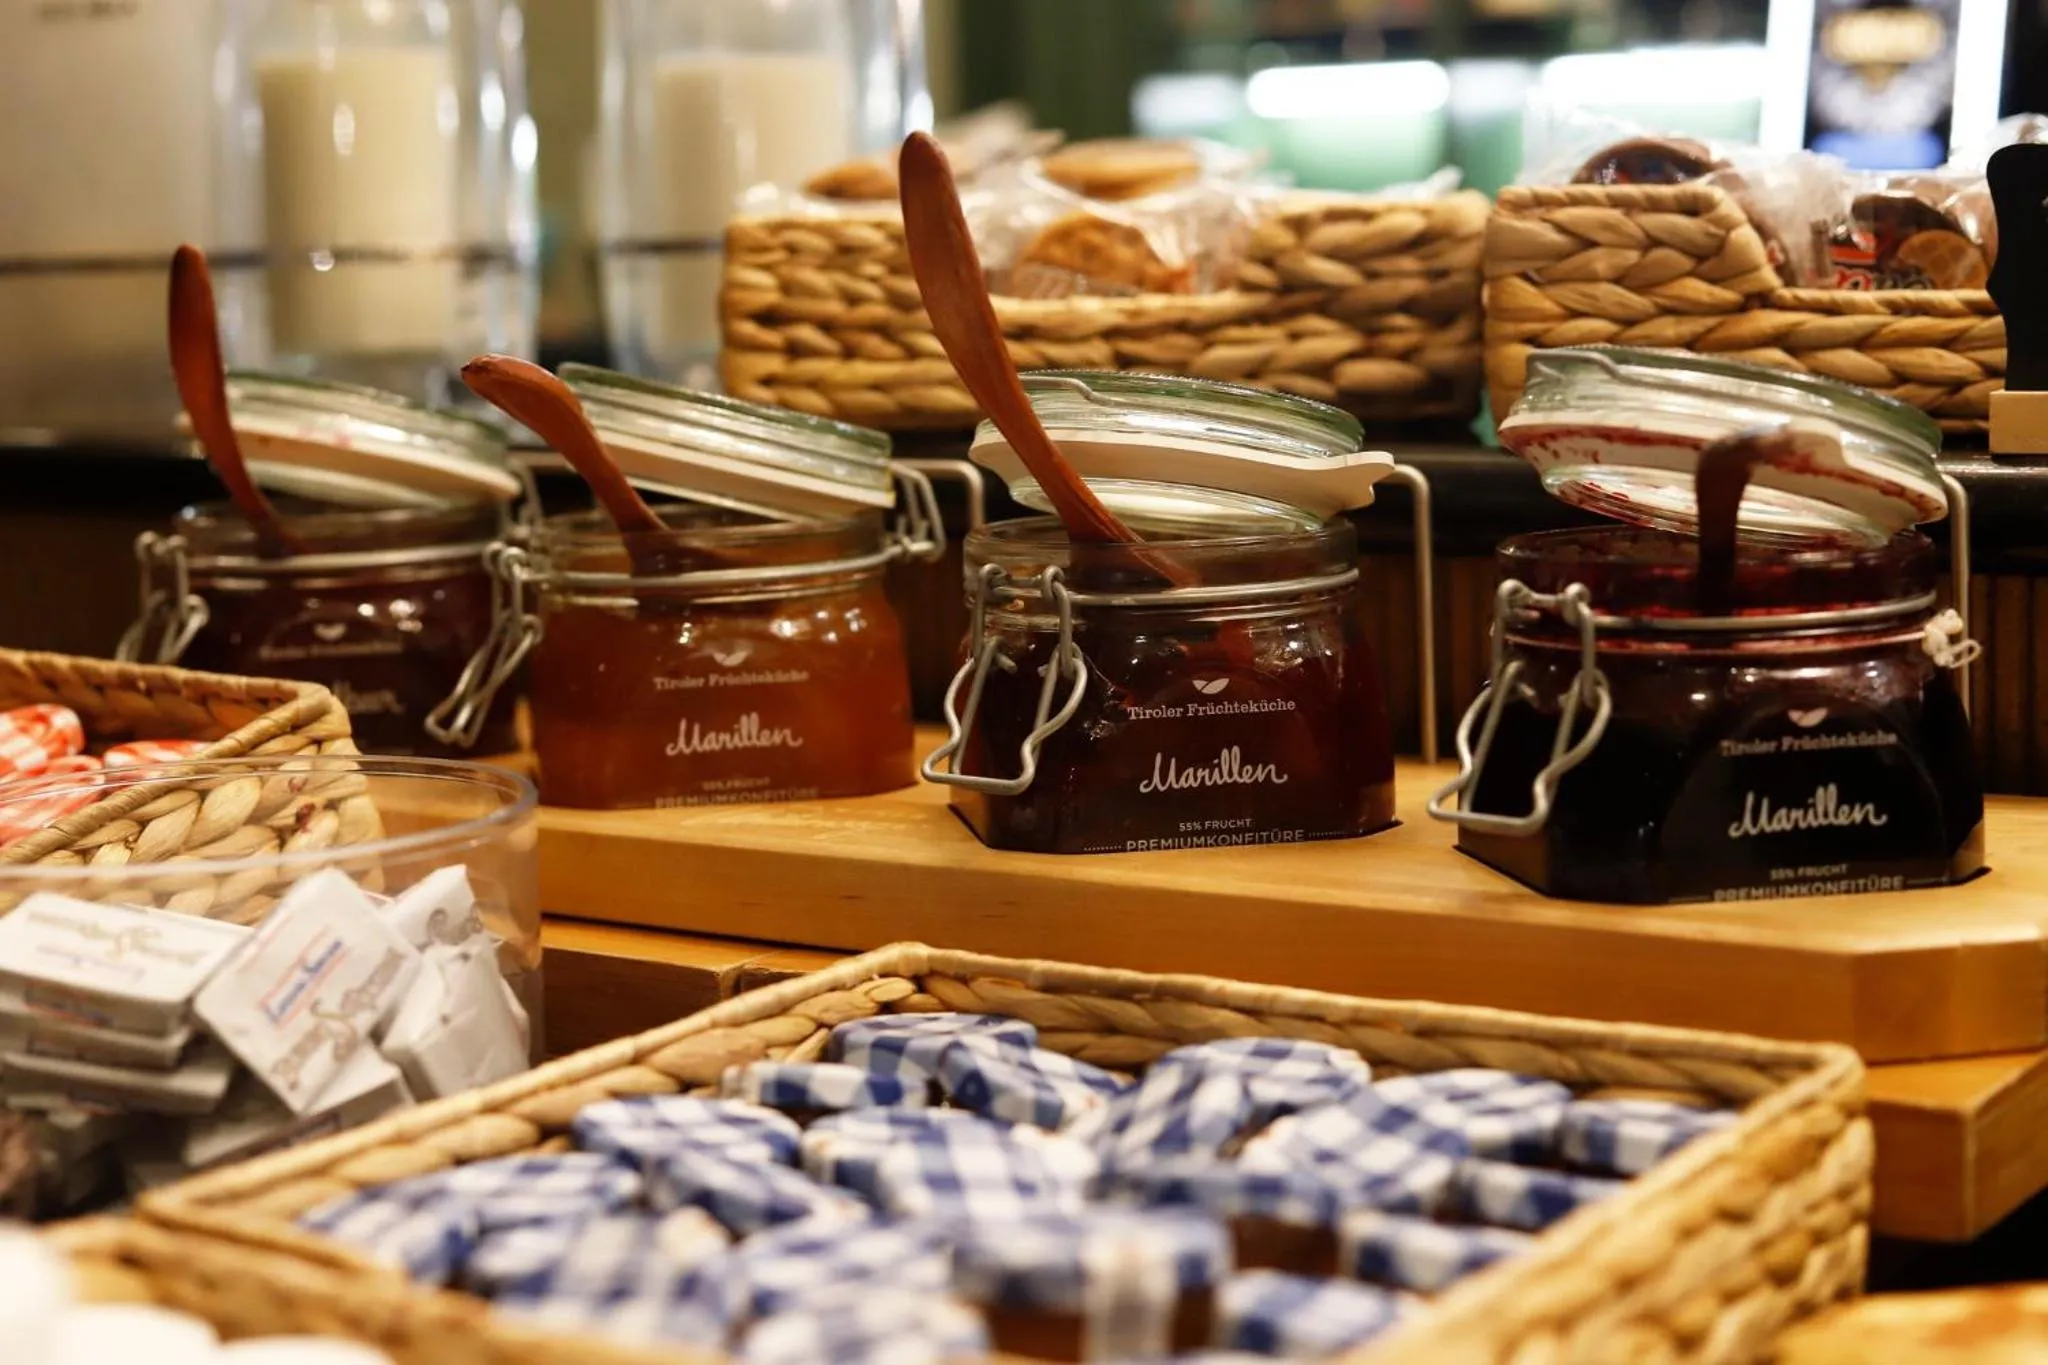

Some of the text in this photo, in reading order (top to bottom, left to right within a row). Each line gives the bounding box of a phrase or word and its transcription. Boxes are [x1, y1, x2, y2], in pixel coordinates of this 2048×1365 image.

[1127, 698, 1296, 720] Tiroler Früchteküche
[665, 711, 803, 756] Marillen
[1720, 730, 1898, 756] Tiroler Früchteküche
[1139, 745, 1288, 794] Marillen
[1728, 783, 1888, 838] Marillen
[1179, 818, 1252, 832] 55% FRUCHT
[1126, 829, 1305, 851] PREMIUMKONFITÜRE
[1797, 863, 1848, 878] FRUCHT
[1713, 874, 1904, 902] PREMIUMKONFITÜRE
